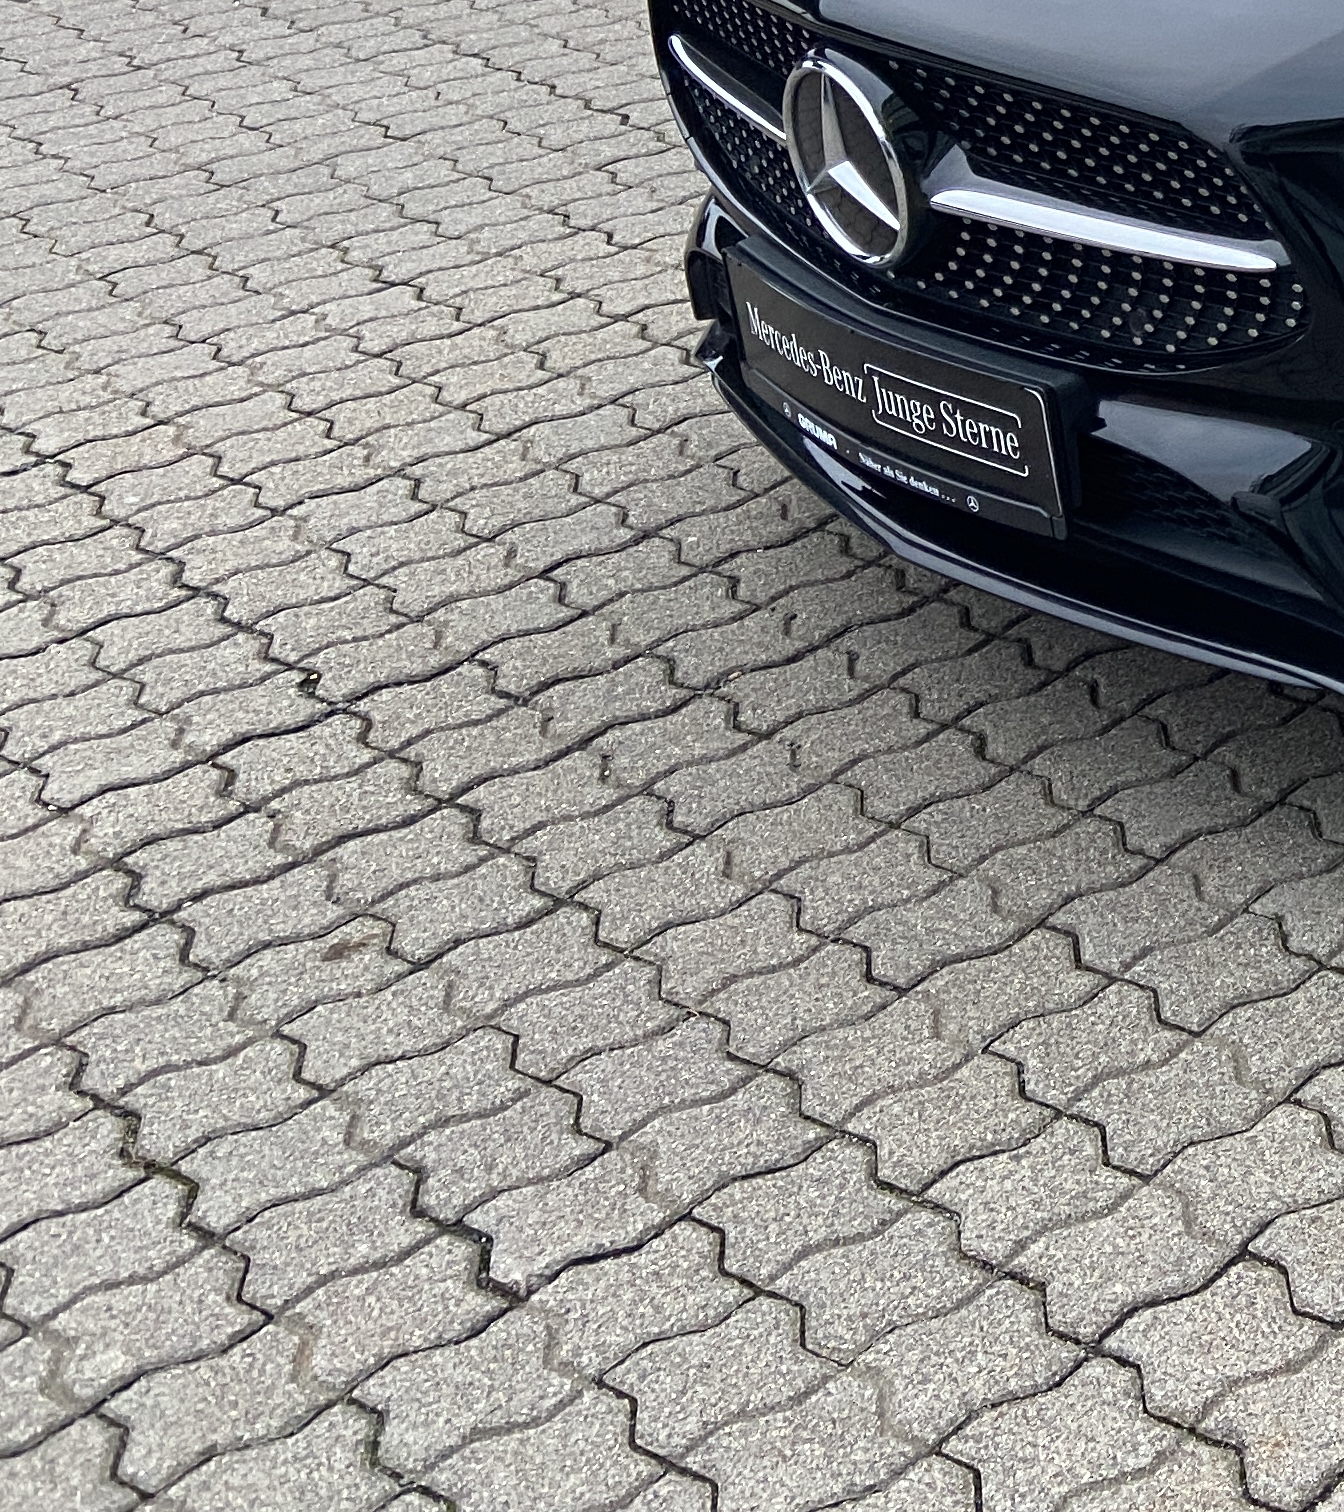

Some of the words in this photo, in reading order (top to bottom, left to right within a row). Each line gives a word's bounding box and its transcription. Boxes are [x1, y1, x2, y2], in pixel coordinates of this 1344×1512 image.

[745, 301, 867, 403] Mercedes-Benz
[871, 375, 936, 433] Junge
[939, 400, 1021, 459] Sterne
